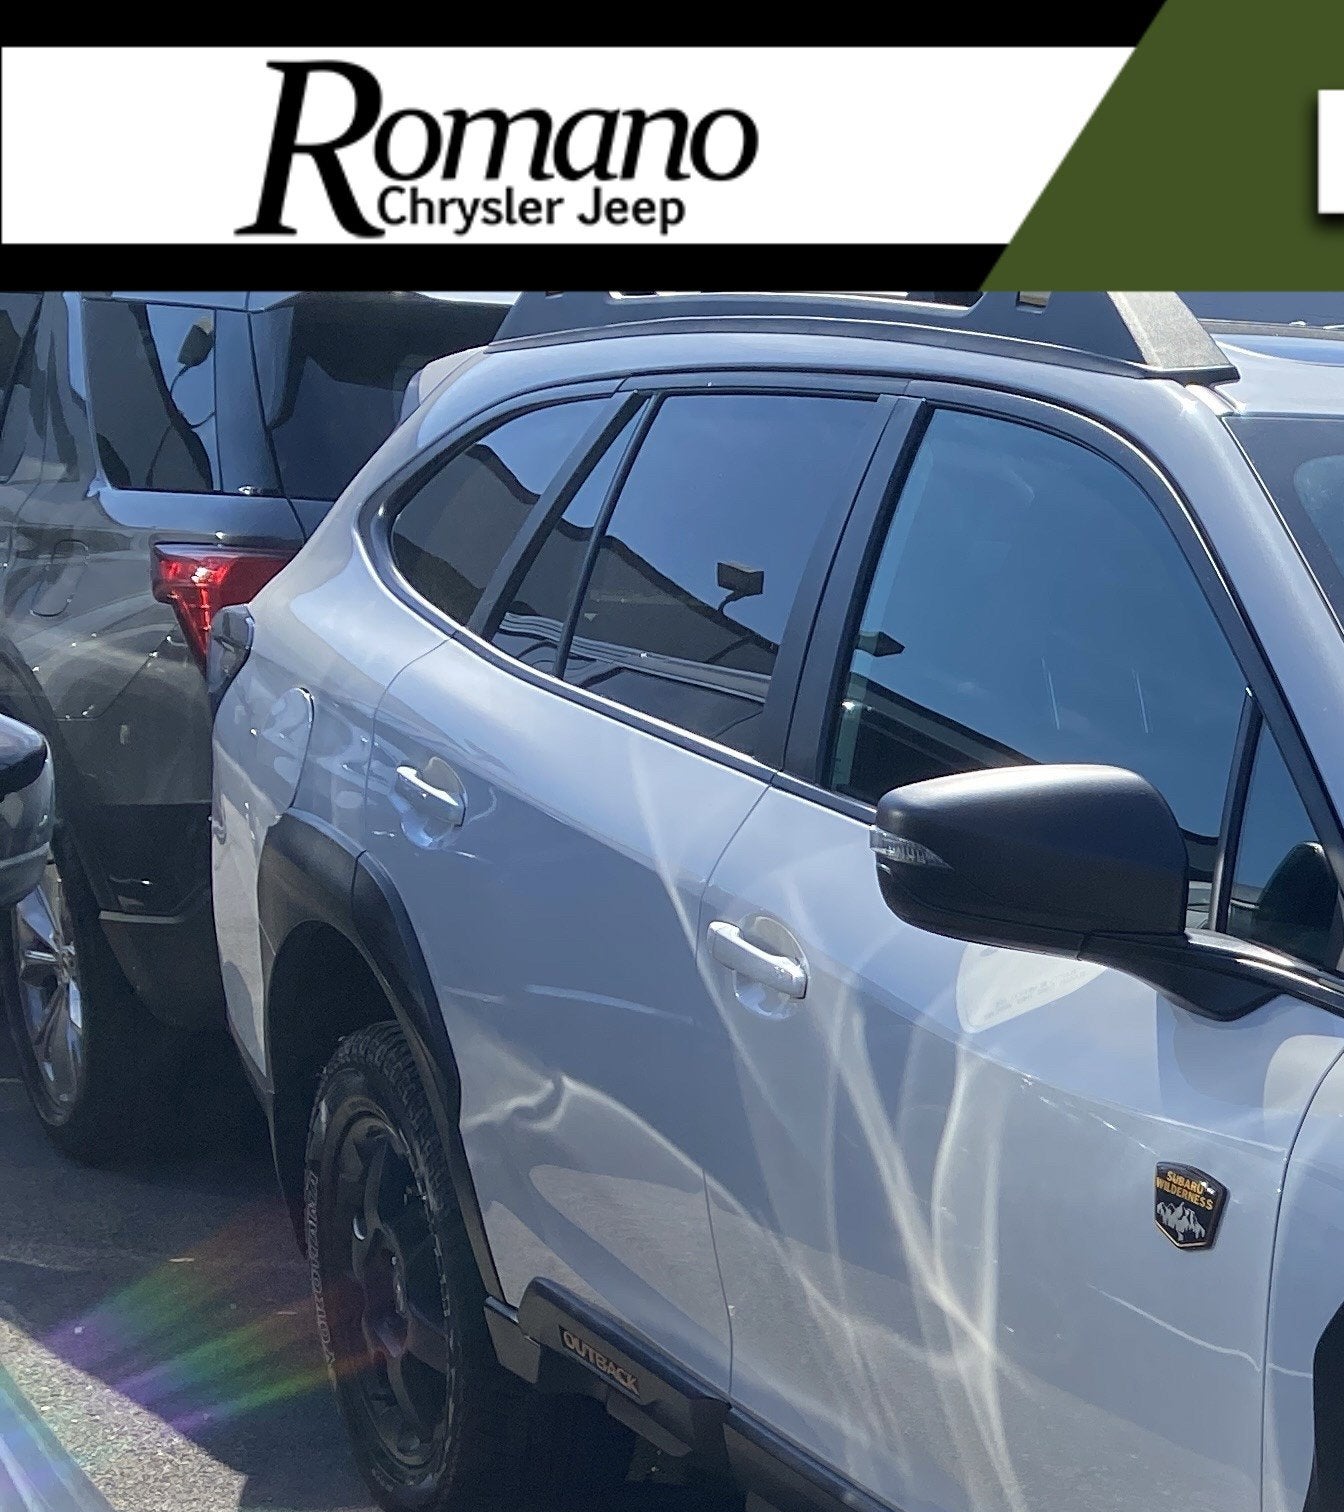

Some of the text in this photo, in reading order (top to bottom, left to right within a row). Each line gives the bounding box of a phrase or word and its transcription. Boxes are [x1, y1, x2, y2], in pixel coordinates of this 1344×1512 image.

[1156, 1176, 1214, 1211] WILDERNESS
[1166, 1170, 1205, 1195] SUBARU
[562, 1330, 642, 1397] OUTBACK
